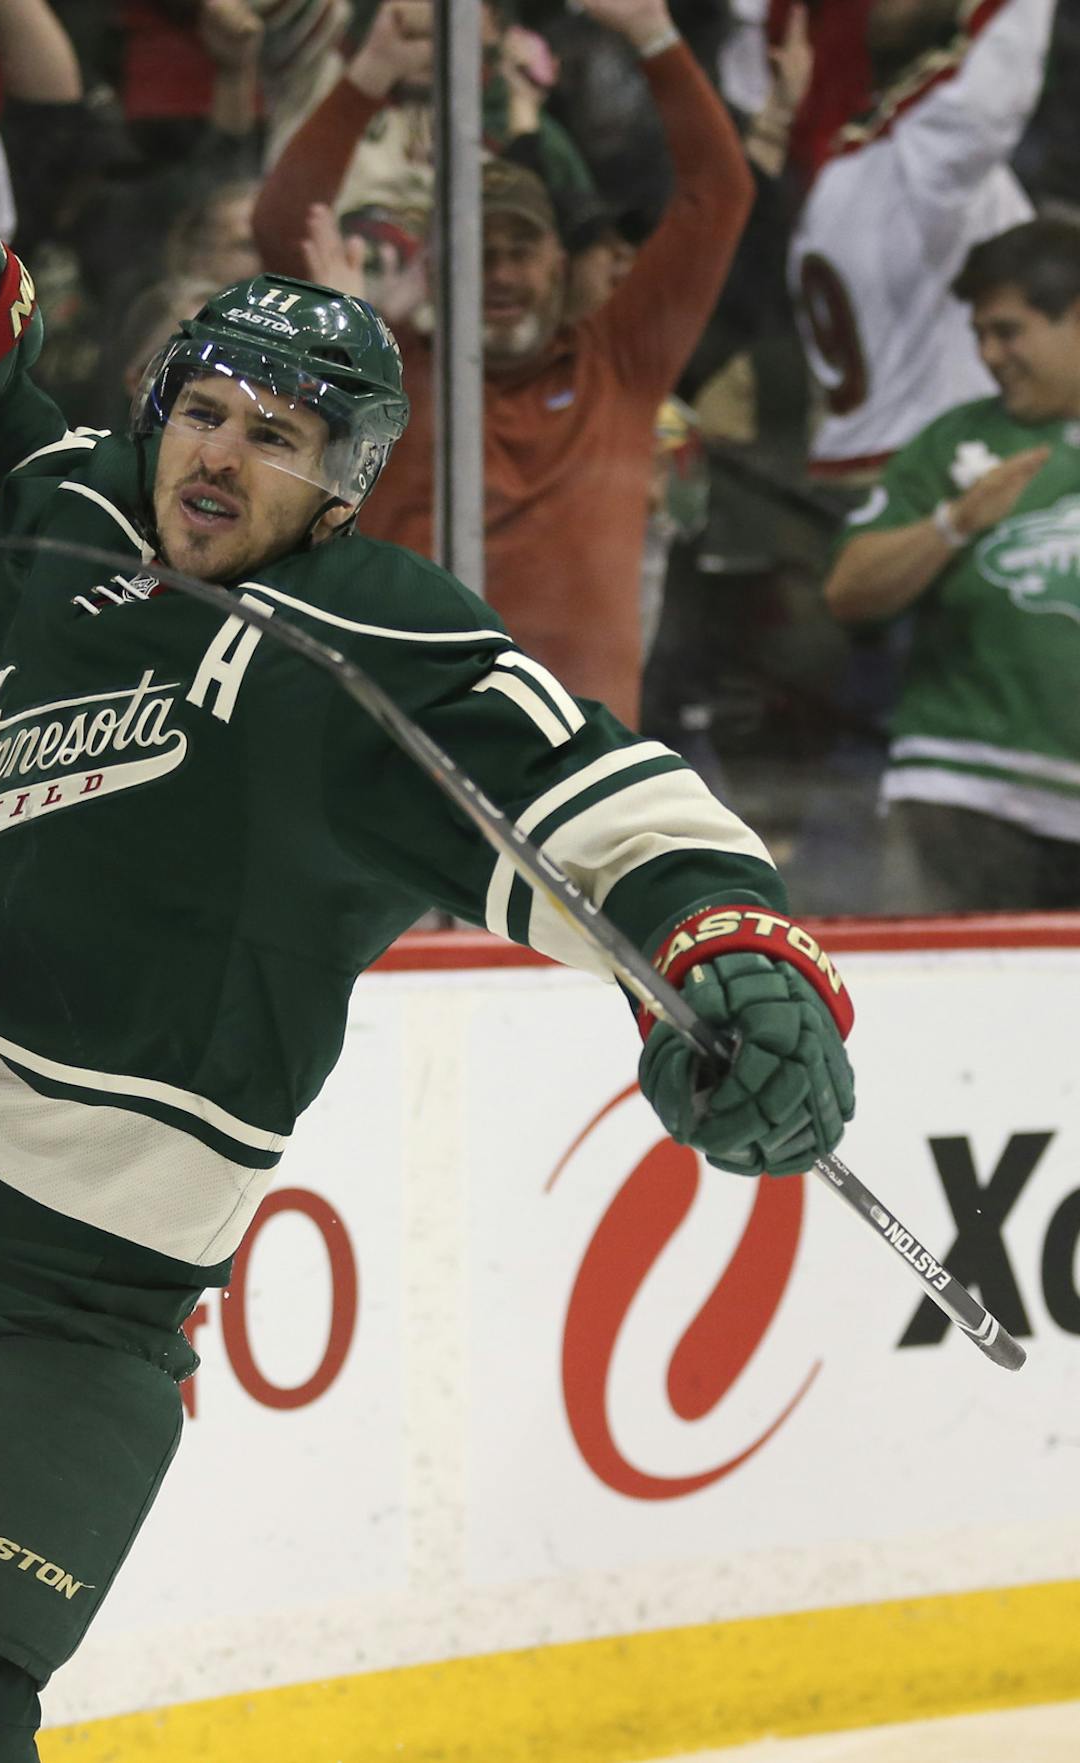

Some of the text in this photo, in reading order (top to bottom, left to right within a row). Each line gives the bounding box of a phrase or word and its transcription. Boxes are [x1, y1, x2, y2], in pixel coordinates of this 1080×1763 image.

[226, 307, 299, 336] EASTON
[186, 593, 275, 723] A
[471, 650, 586, 748] 11
[653, 911, 843, 994] ASTON
[884, 1221, 952, 1291] EASTON
